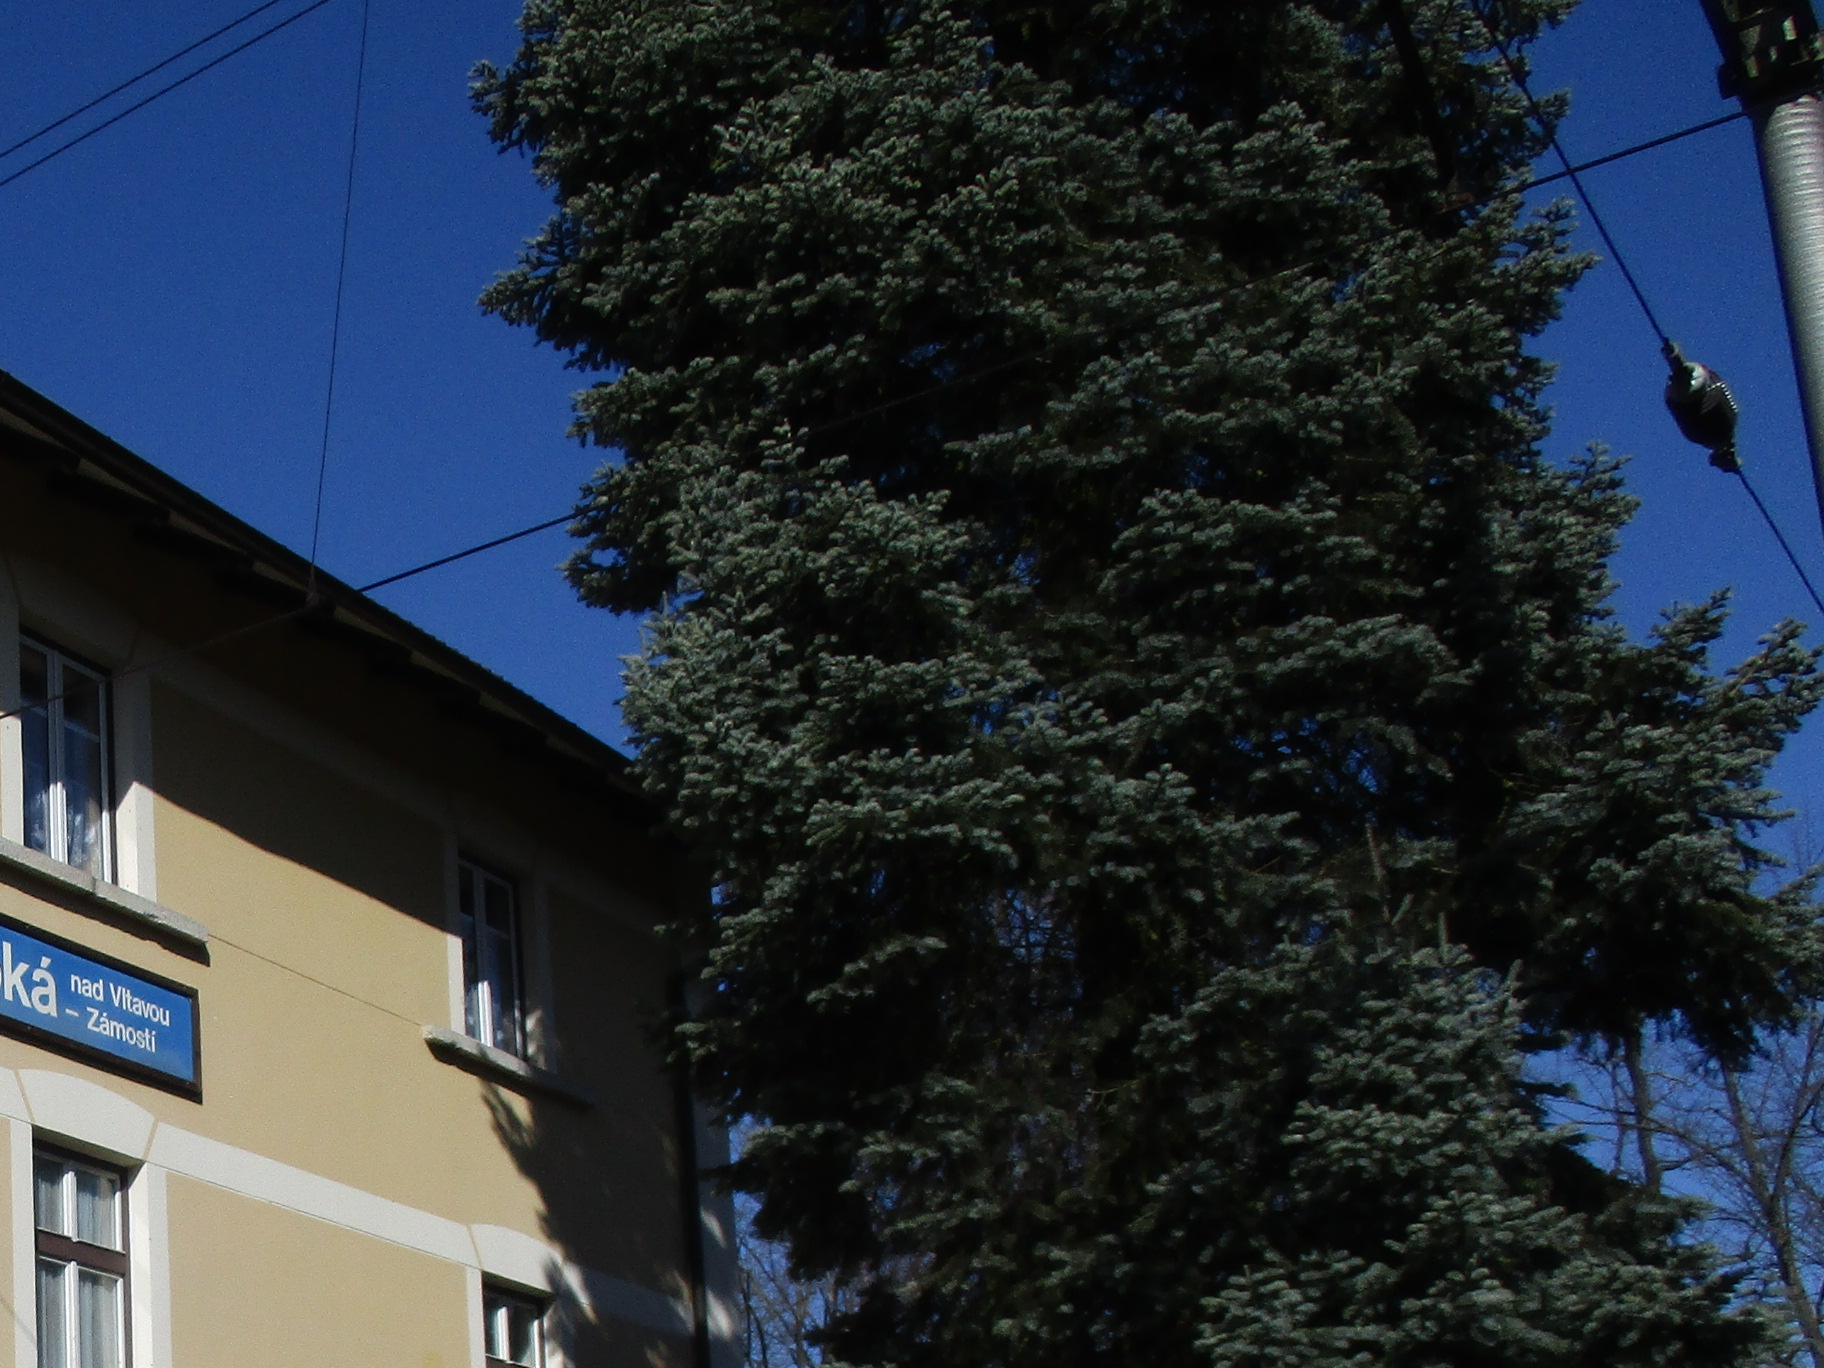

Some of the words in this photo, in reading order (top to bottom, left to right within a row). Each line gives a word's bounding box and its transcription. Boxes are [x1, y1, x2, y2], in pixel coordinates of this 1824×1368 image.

[70, 972, 104, 1002] nad
[109, 982, 171, 1028] Vltavou
[86, 1007, 157, 1053] Zámostí
